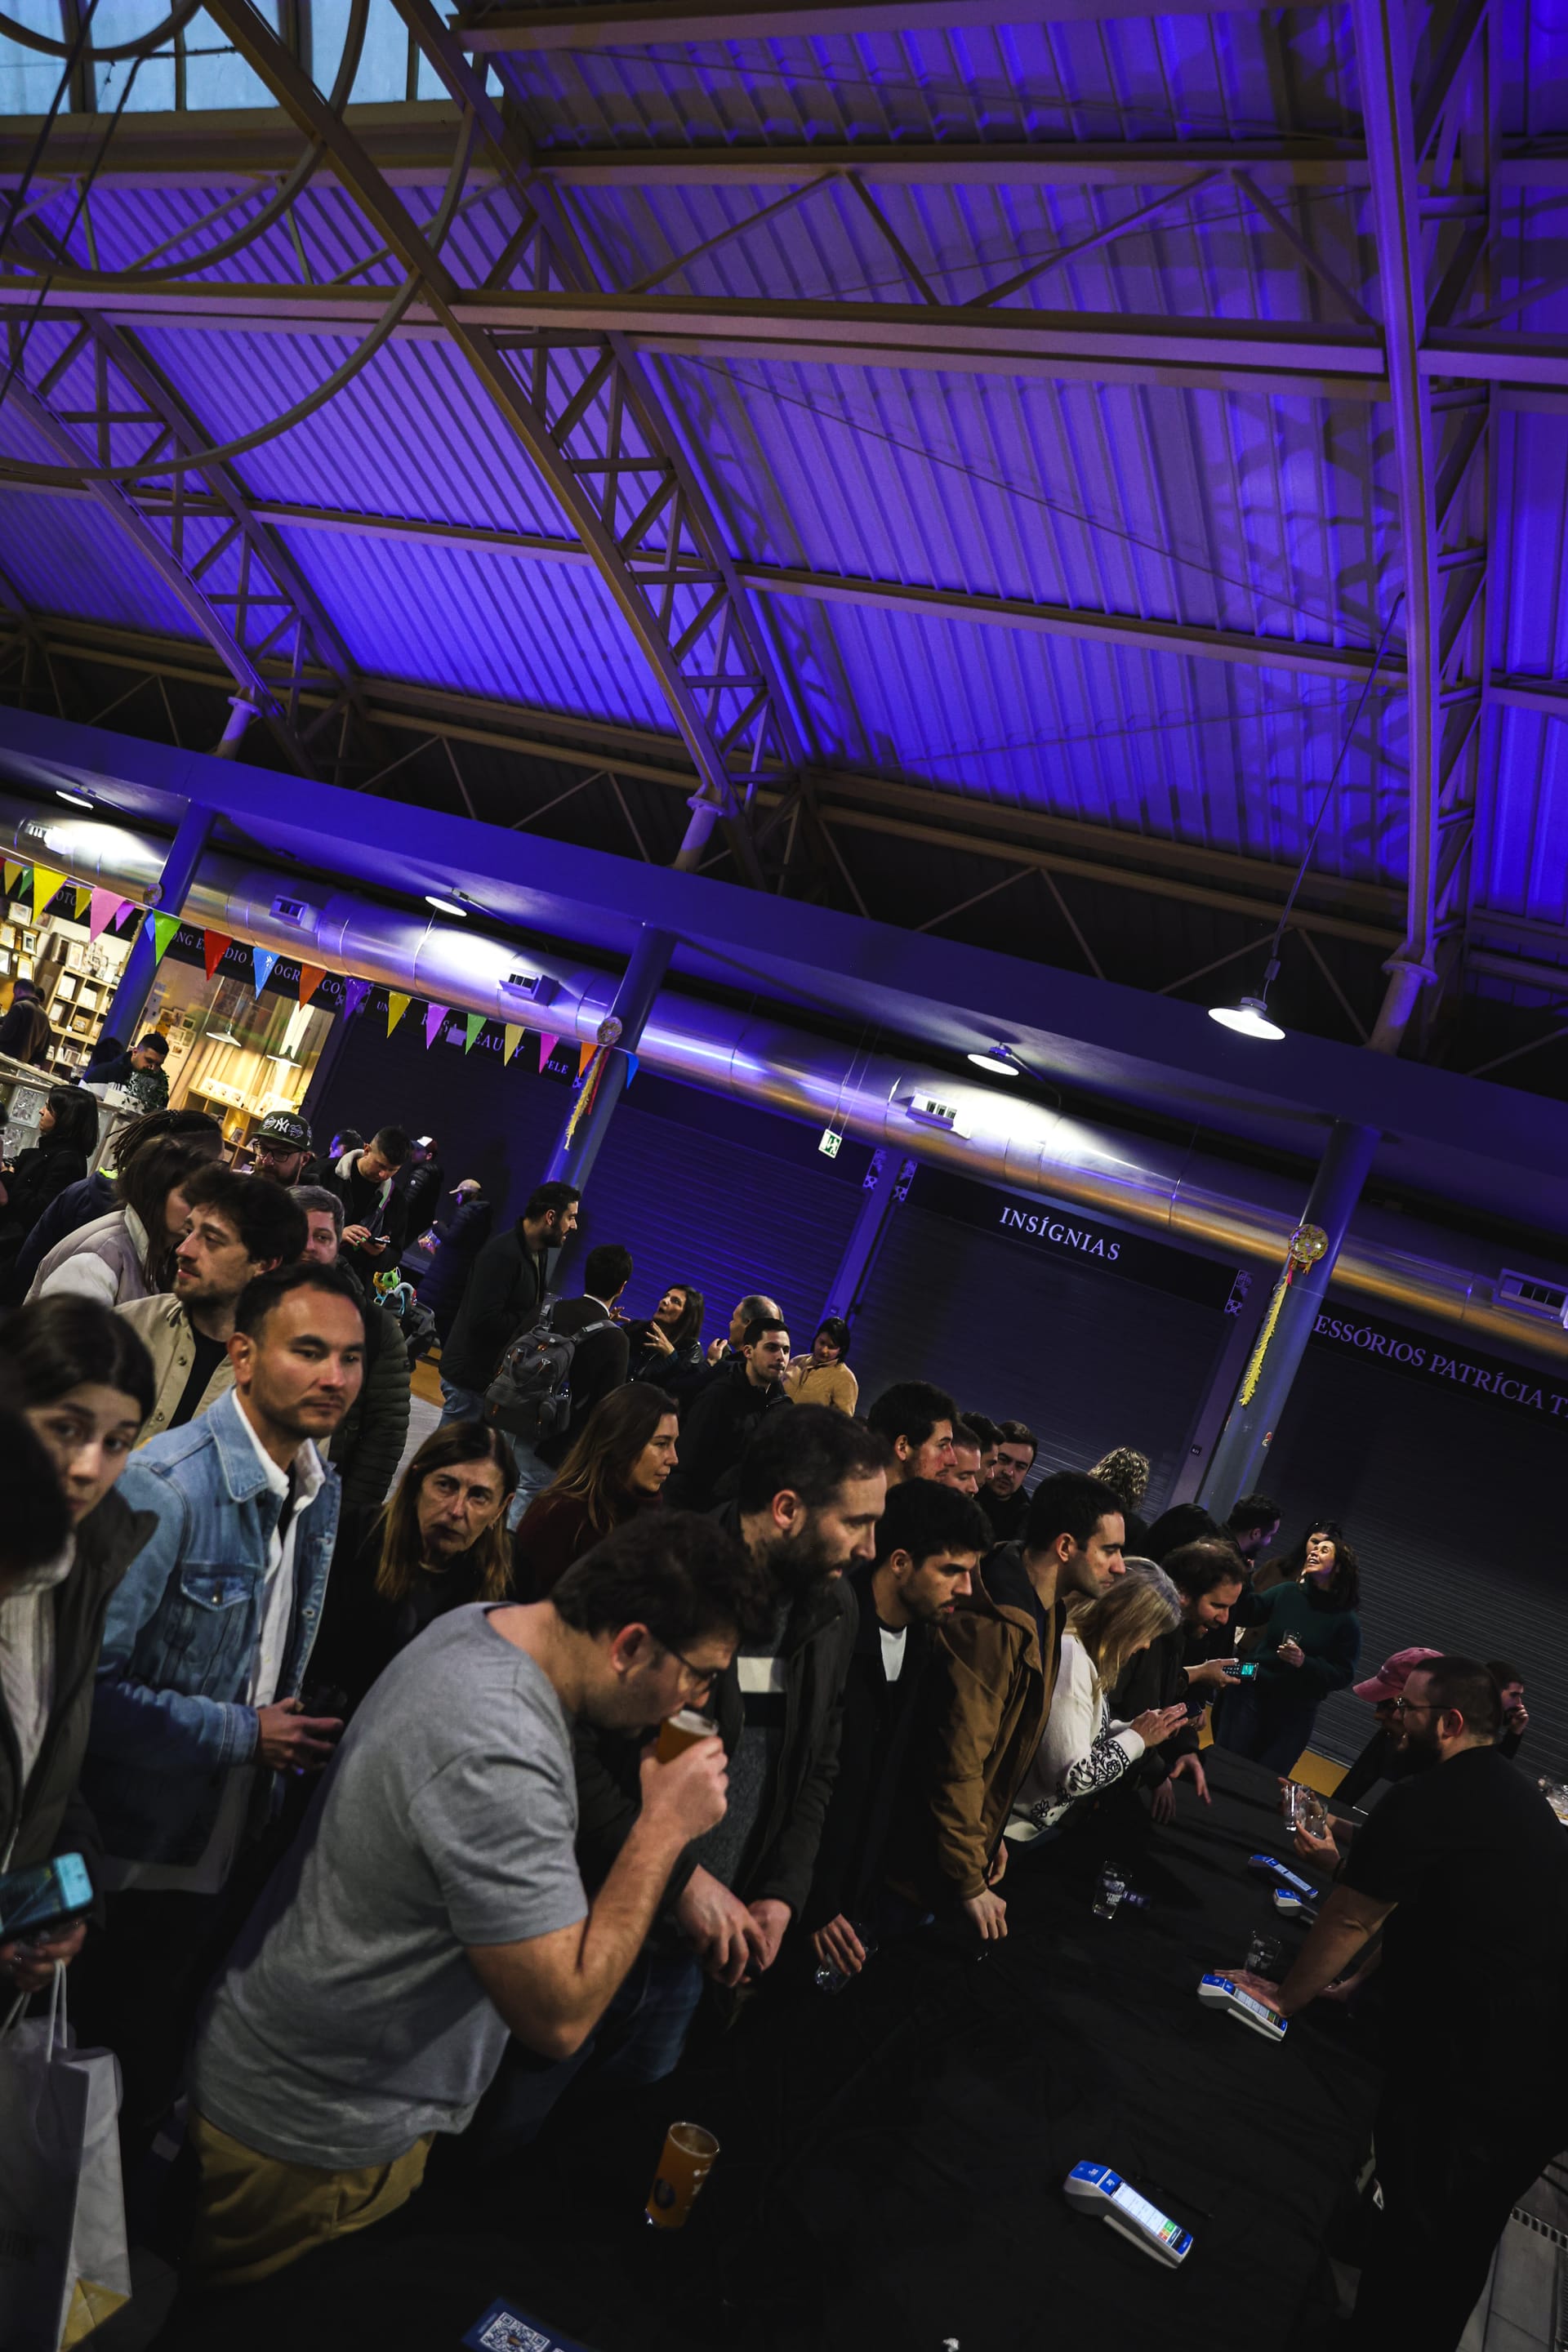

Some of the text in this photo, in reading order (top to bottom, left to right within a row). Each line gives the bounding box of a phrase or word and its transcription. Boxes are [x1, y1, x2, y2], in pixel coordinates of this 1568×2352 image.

[474, 1031, 525, 1058] EAUY
[999, 1206, 1121, 1261] INSÍGNIAS
[1312, 1314, 1568, 1418] ESSÓRIOS PATRÍCIA T
